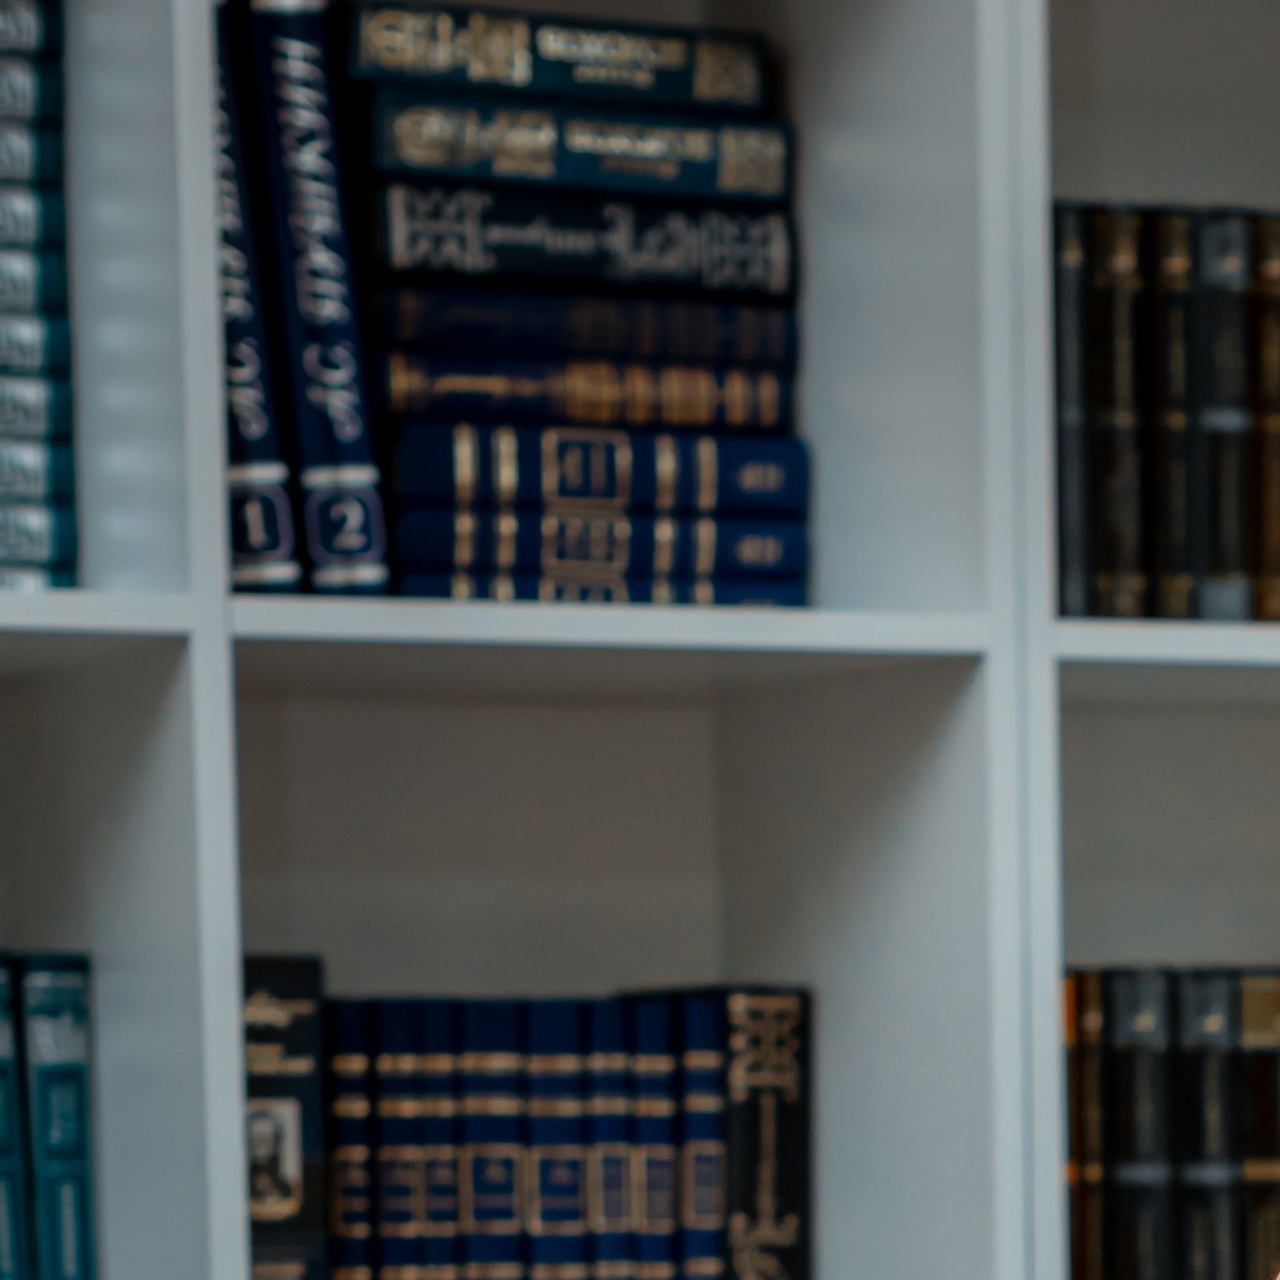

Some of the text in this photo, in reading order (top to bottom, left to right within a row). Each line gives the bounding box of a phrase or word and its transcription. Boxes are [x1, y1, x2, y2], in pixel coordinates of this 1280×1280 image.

[270, 35, 351, 326] ПУШКИН
[243, 498, 268, 550] 1
[328, 496, 368, 551] 2
